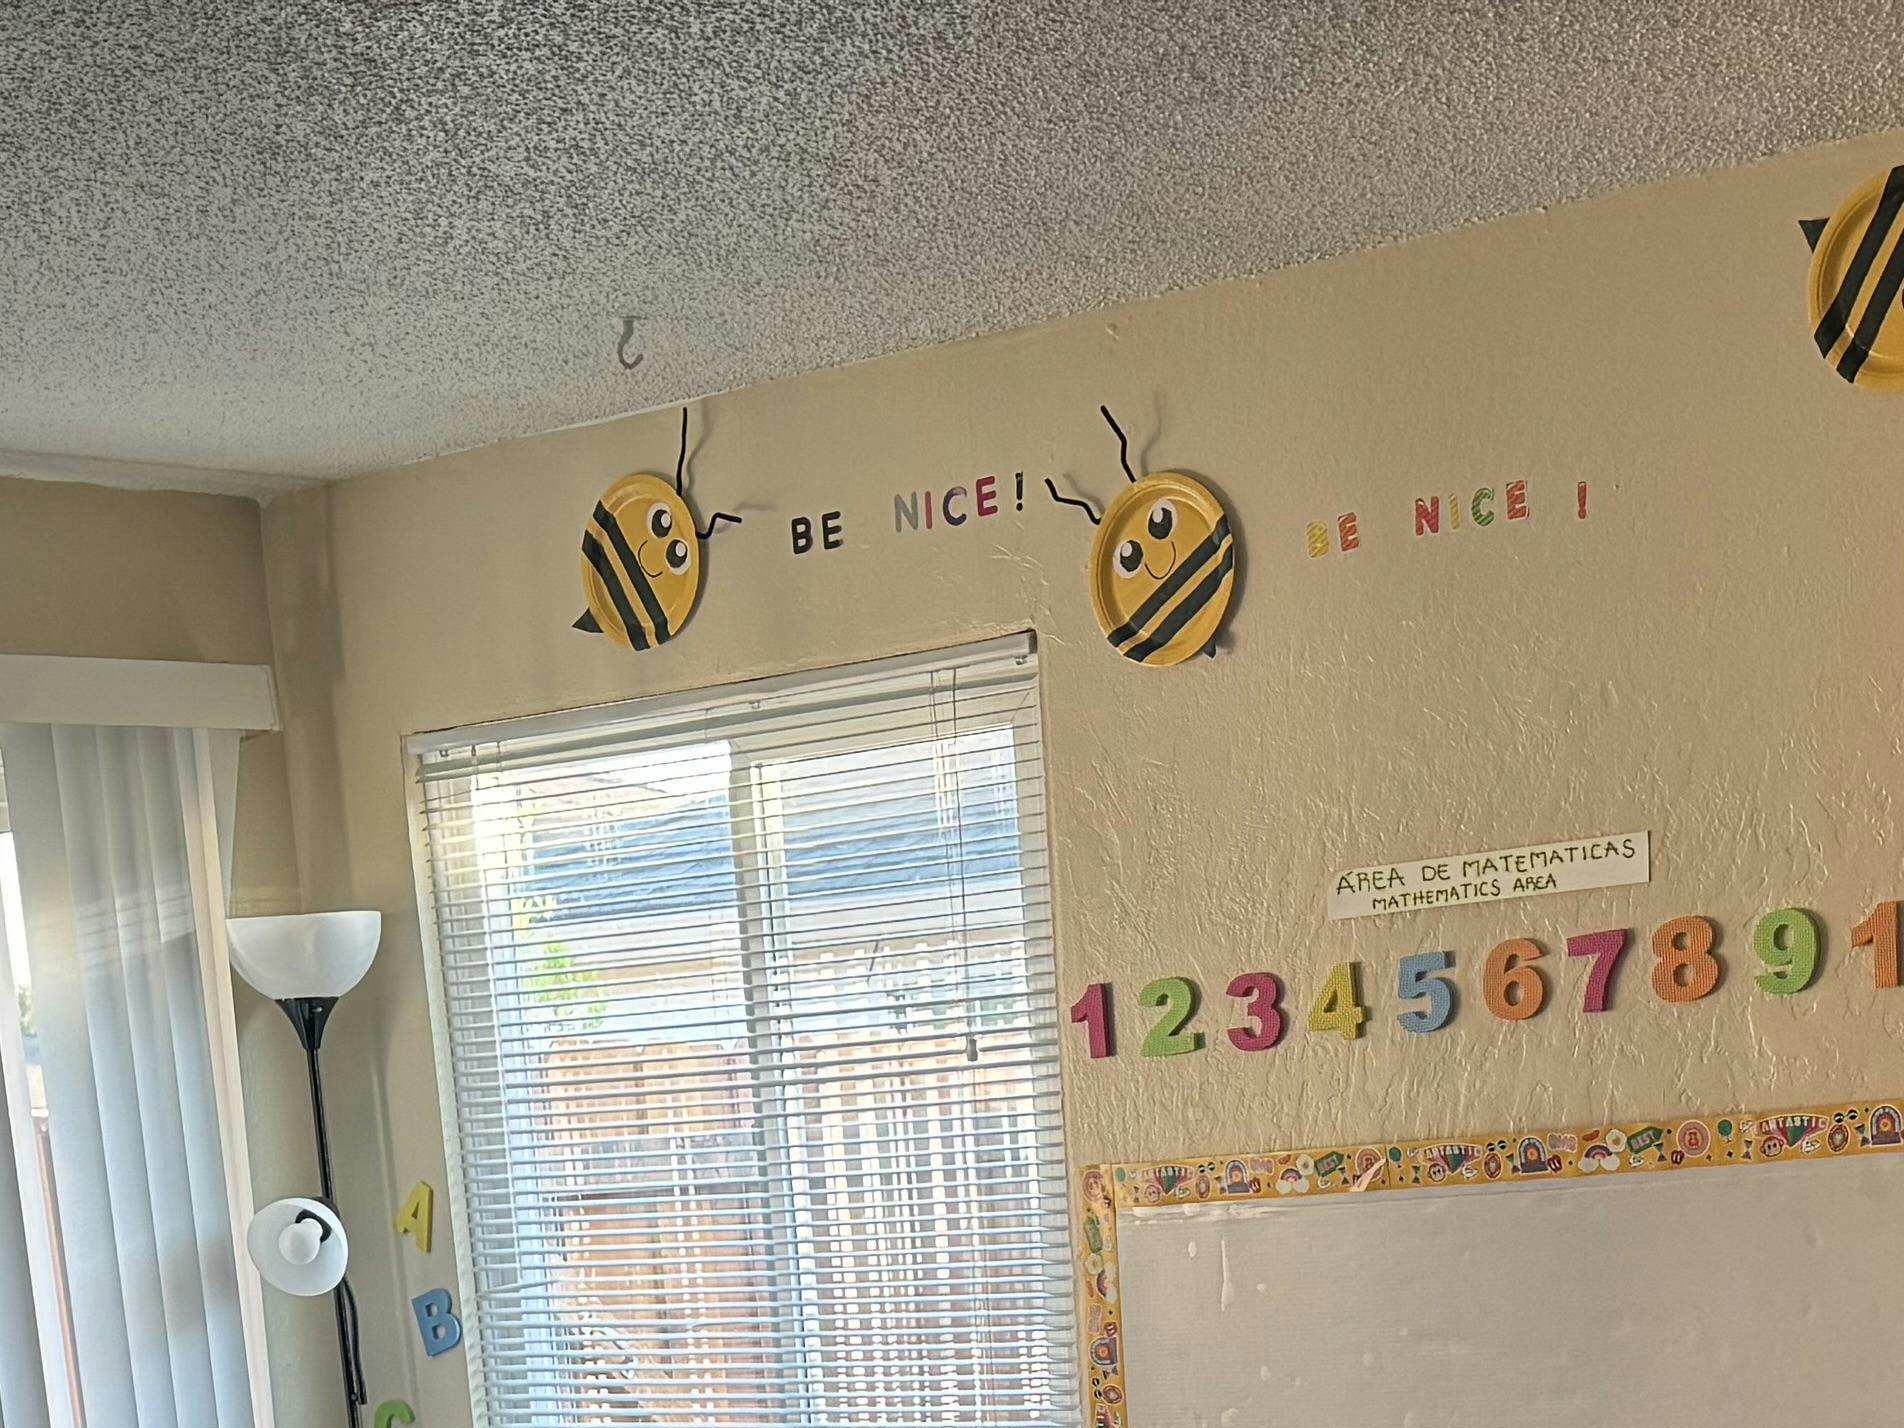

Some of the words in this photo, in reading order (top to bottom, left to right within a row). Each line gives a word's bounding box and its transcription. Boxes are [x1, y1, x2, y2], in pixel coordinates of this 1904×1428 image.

[792, 511, 843, 554] BE
[1306, 512, 1359, 558] BE
[1414, 480, 1529, 536] NICE
[1373, 880, 1501, 910] MATHEMATICS
[1513, 873, 1556, 891] AREA
[1422, 864, 1450, 882] DE
[1463, 838, 1636, 877] MATEMATICAS
[1069, 983, 1116, 1058] 1
[1138, 976, 1205, 1057] 2
[1226, 973, 1287, 1052] 3
[1307, 962, 1368, 1040] 4
[1397, 952, 1457, 1034] 5
[1483, 938, 1548, 1021] 6
[1567, 929, 1630, 1013] 7
[1651, 916, 1721, 1002] 8
[1754, 908, 1822, 995] 9
[396, 1180, 434, 1253] A
[412, 1288, 461, 1357] B
